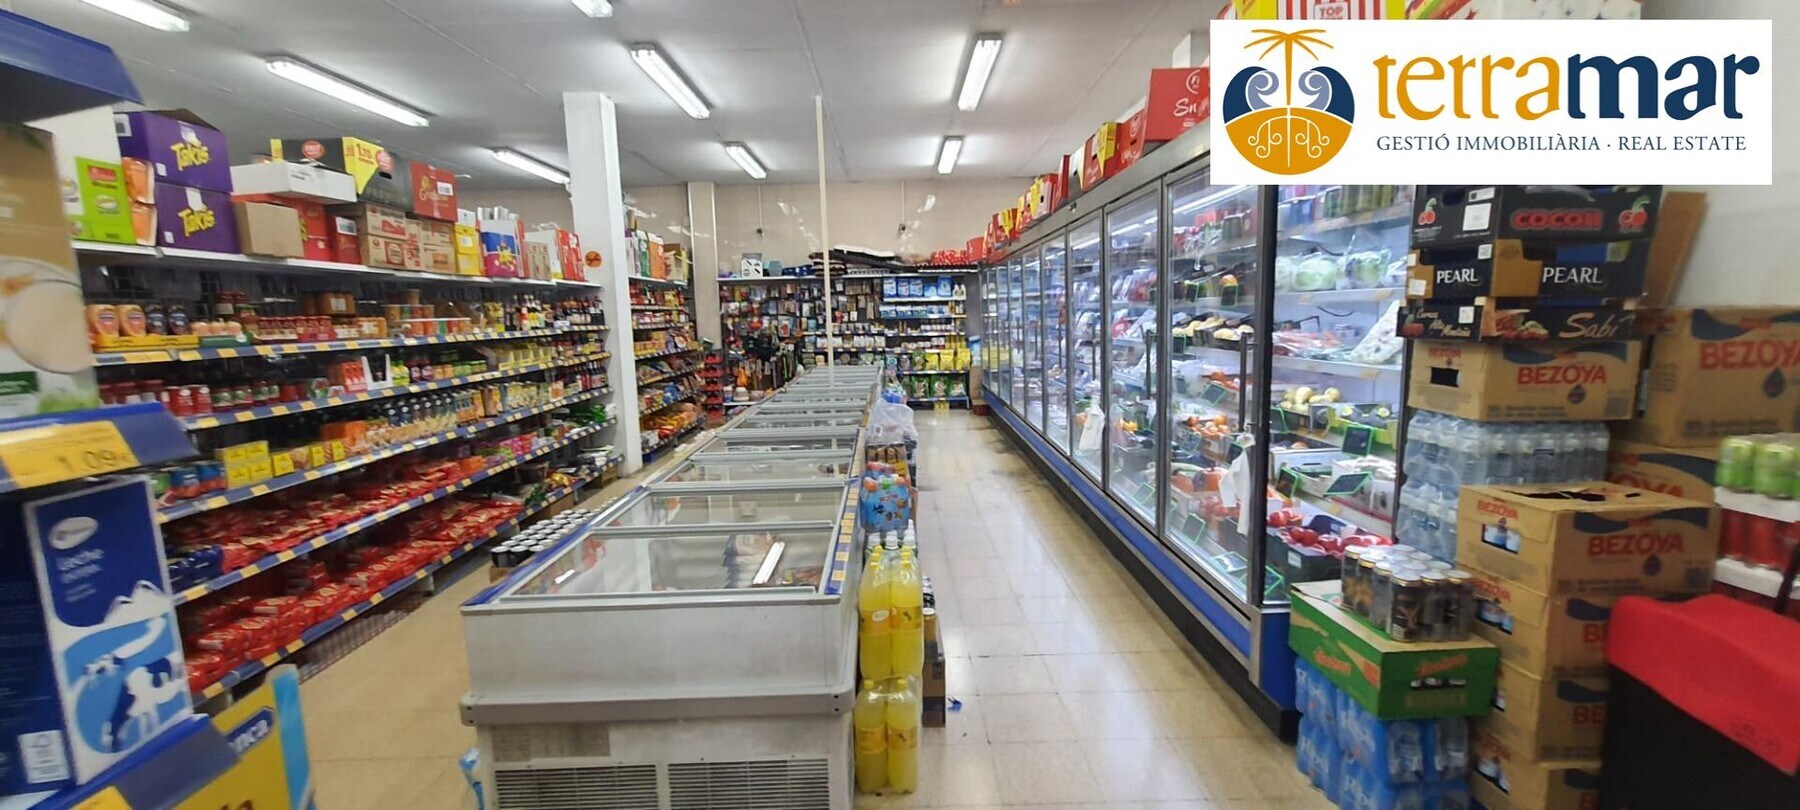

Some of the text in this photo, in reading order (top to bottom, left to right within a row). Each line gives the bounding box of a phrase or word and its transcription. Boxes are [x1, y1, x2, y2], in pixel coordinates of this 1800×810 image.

[1319, 7, 1343, 16] TOP
[170, 142, 211, 172] Takis
[177, 208, 216, 238] Takis
[1436, 268, 1479, 284] PEARL
[1542, 266, 1604, 285] PEARL
[1517, 364, 1607, 386] BEZOYA
[1477, 499, 1519, 519] BEZOYA
[1587, 532, 1685, 558] BEZOYA
